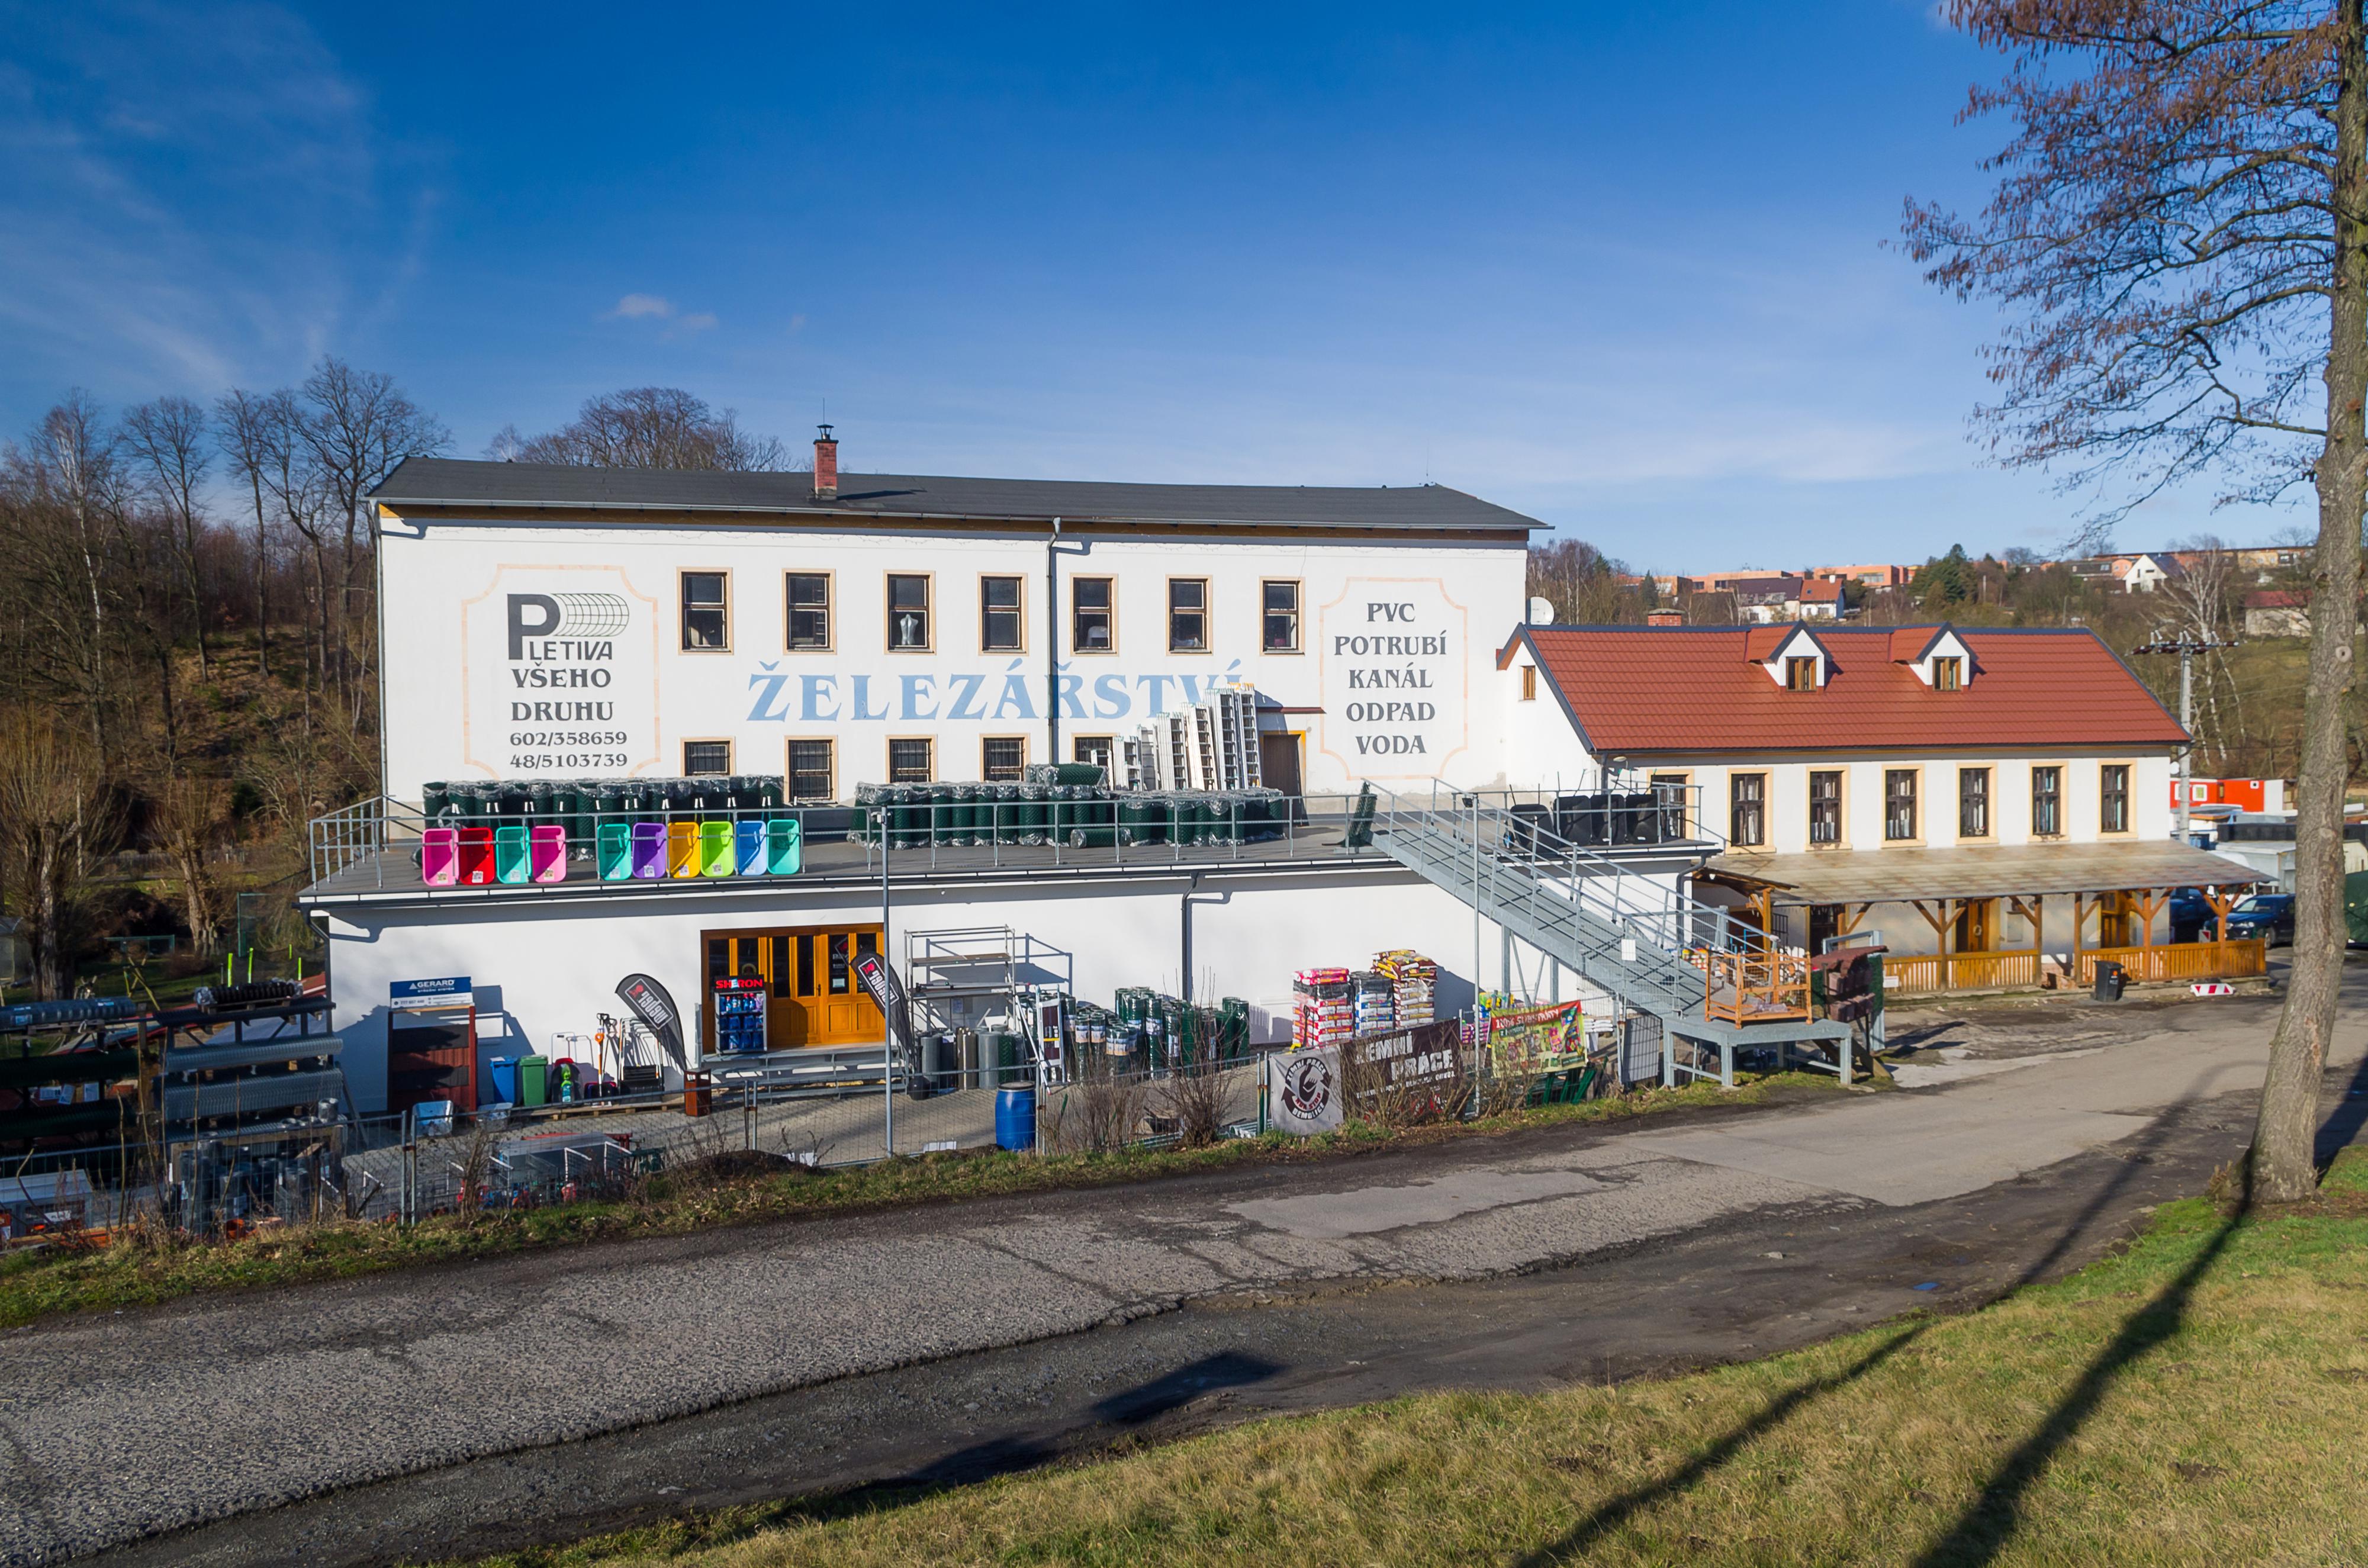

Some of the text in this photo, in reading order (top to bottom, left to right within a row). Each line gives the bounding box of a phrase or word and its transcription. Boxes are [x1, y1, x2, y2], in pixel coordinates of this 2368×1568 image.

[1366, 602, 1416, 623] PVC
[507, 593, 613, 661] PLETIVA
[1334, 629, 1447, 656] POTRUBÍ
[510, 661, 612, 688] VŠEHO
[1348, 661, 1434, 688] KANÁL
[510, 701, 614, 721] DRUHU
[1346, 702, 1436, 722] ODPAD
[509, 732, 628, 746] 602/358659
[1355, 735, 1427, 755] VODA
[509, 754, 628, 769] 48/5103739
[417, 979, 455, 988] GERARD
[716, 978, 763, 989] SHERON
[1292, 1102, 1325, 1119] DEMOLICE
